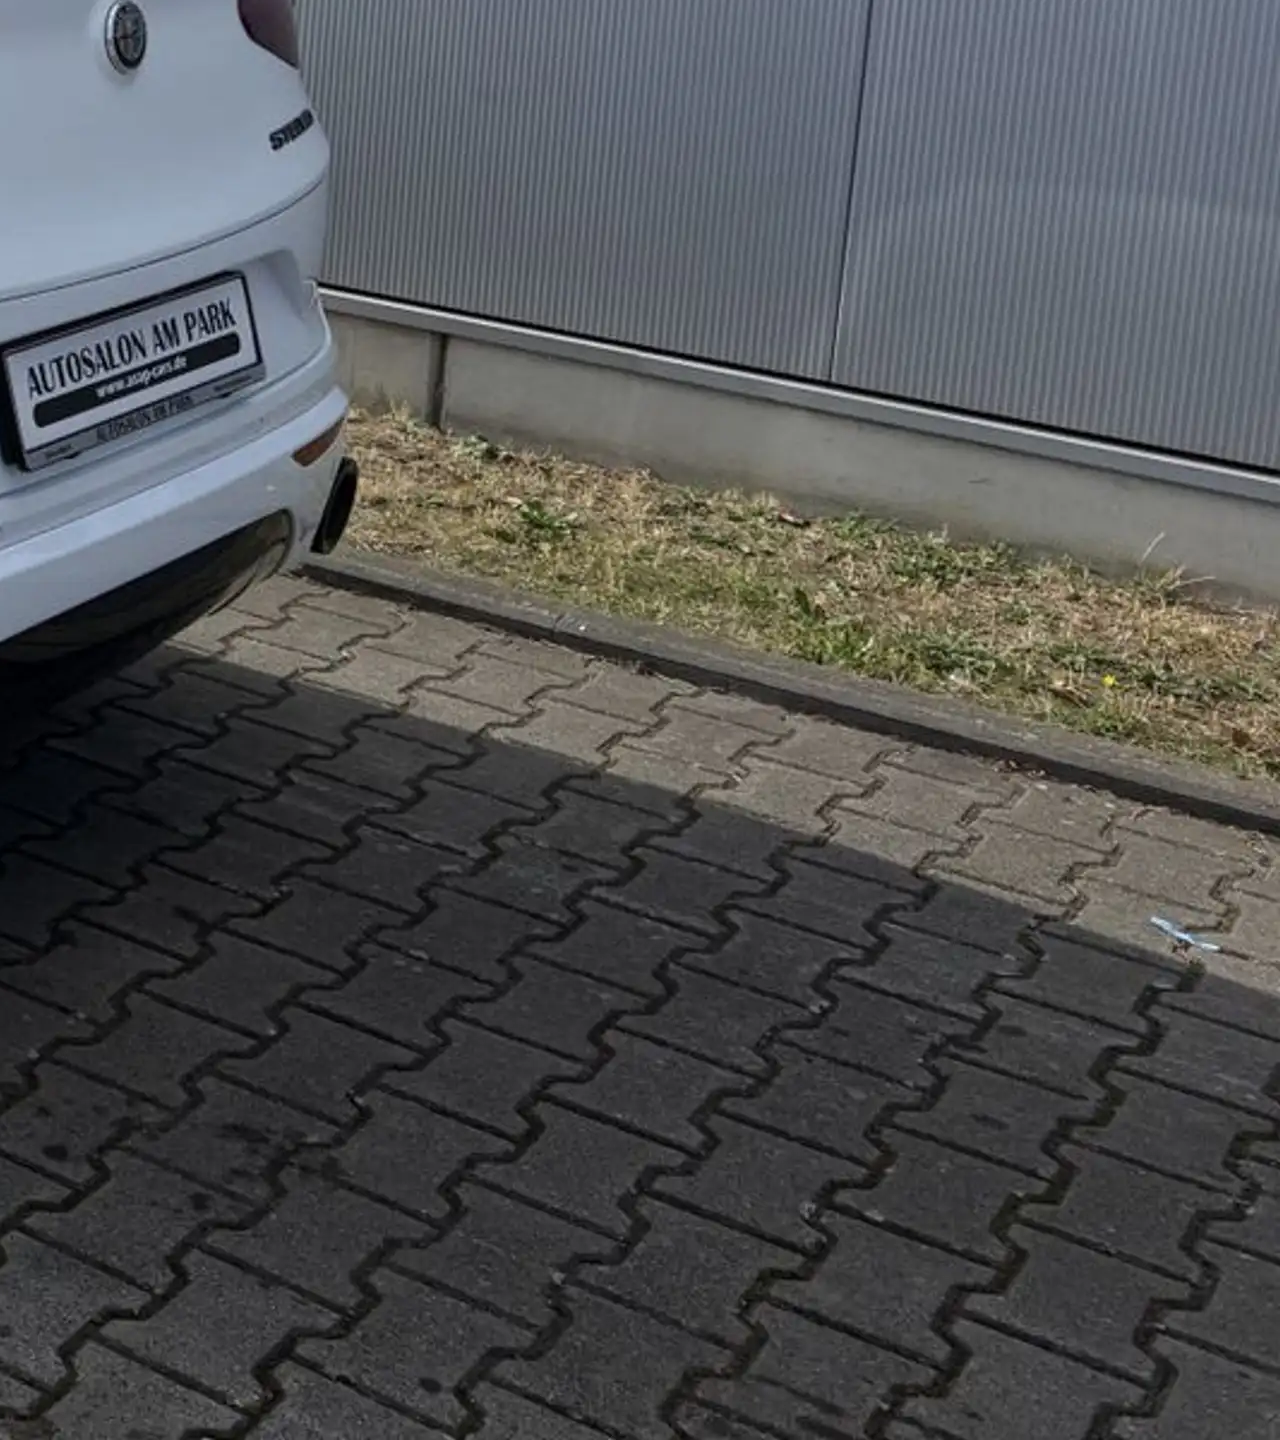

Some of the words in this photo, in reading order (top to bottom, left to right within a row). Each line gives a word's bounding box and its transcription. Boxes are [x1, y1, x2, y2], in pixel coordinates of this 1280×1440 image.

[27, 330, 148, 399] AUTOSALON
[152, 316, 181, 359] AM
[182, 297, 238, 340] PARK
